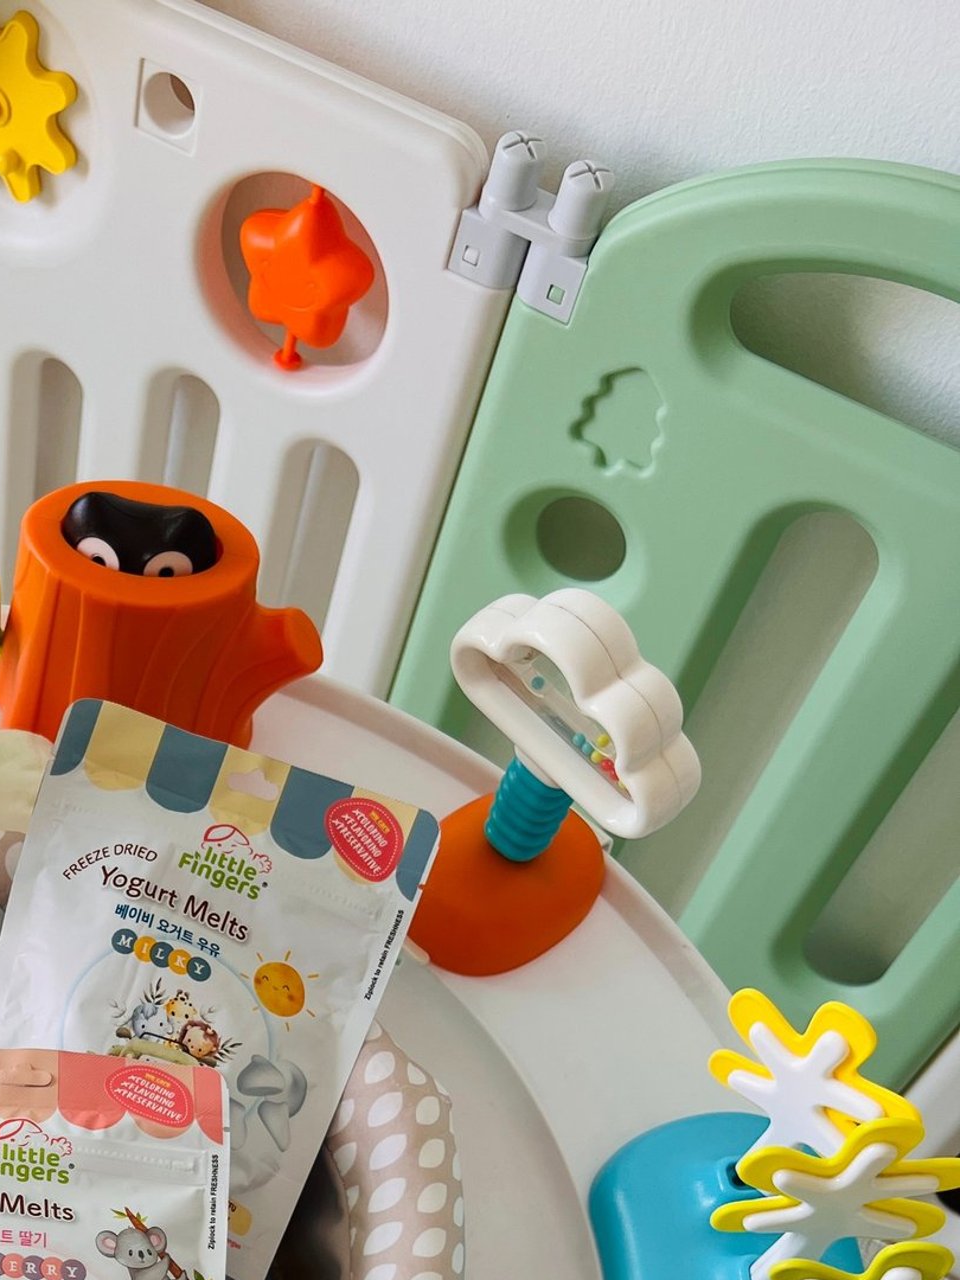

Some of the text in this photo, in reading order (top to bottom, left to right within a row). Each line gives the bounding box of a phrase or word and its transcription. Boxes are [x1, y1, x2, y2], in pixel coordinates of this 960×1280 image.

[62, 843, 159, 881] FREEZE DRIED
[178, 850, 261, 900] Fingers
[204, 846, 258, 881] little
[100, 864, 249, 942] Yogurt Melts
[114, 903, 221, 958] 베이비 요거트 우유
[117, 933, 205, 977] MILKY
[3, 1144, 60, 1167] little
[210, 1154, 219, 1196] FRESHNESS
[0, 1192, 74, 1221] Melts
[19, 1231, 47, 1248] 딸기
